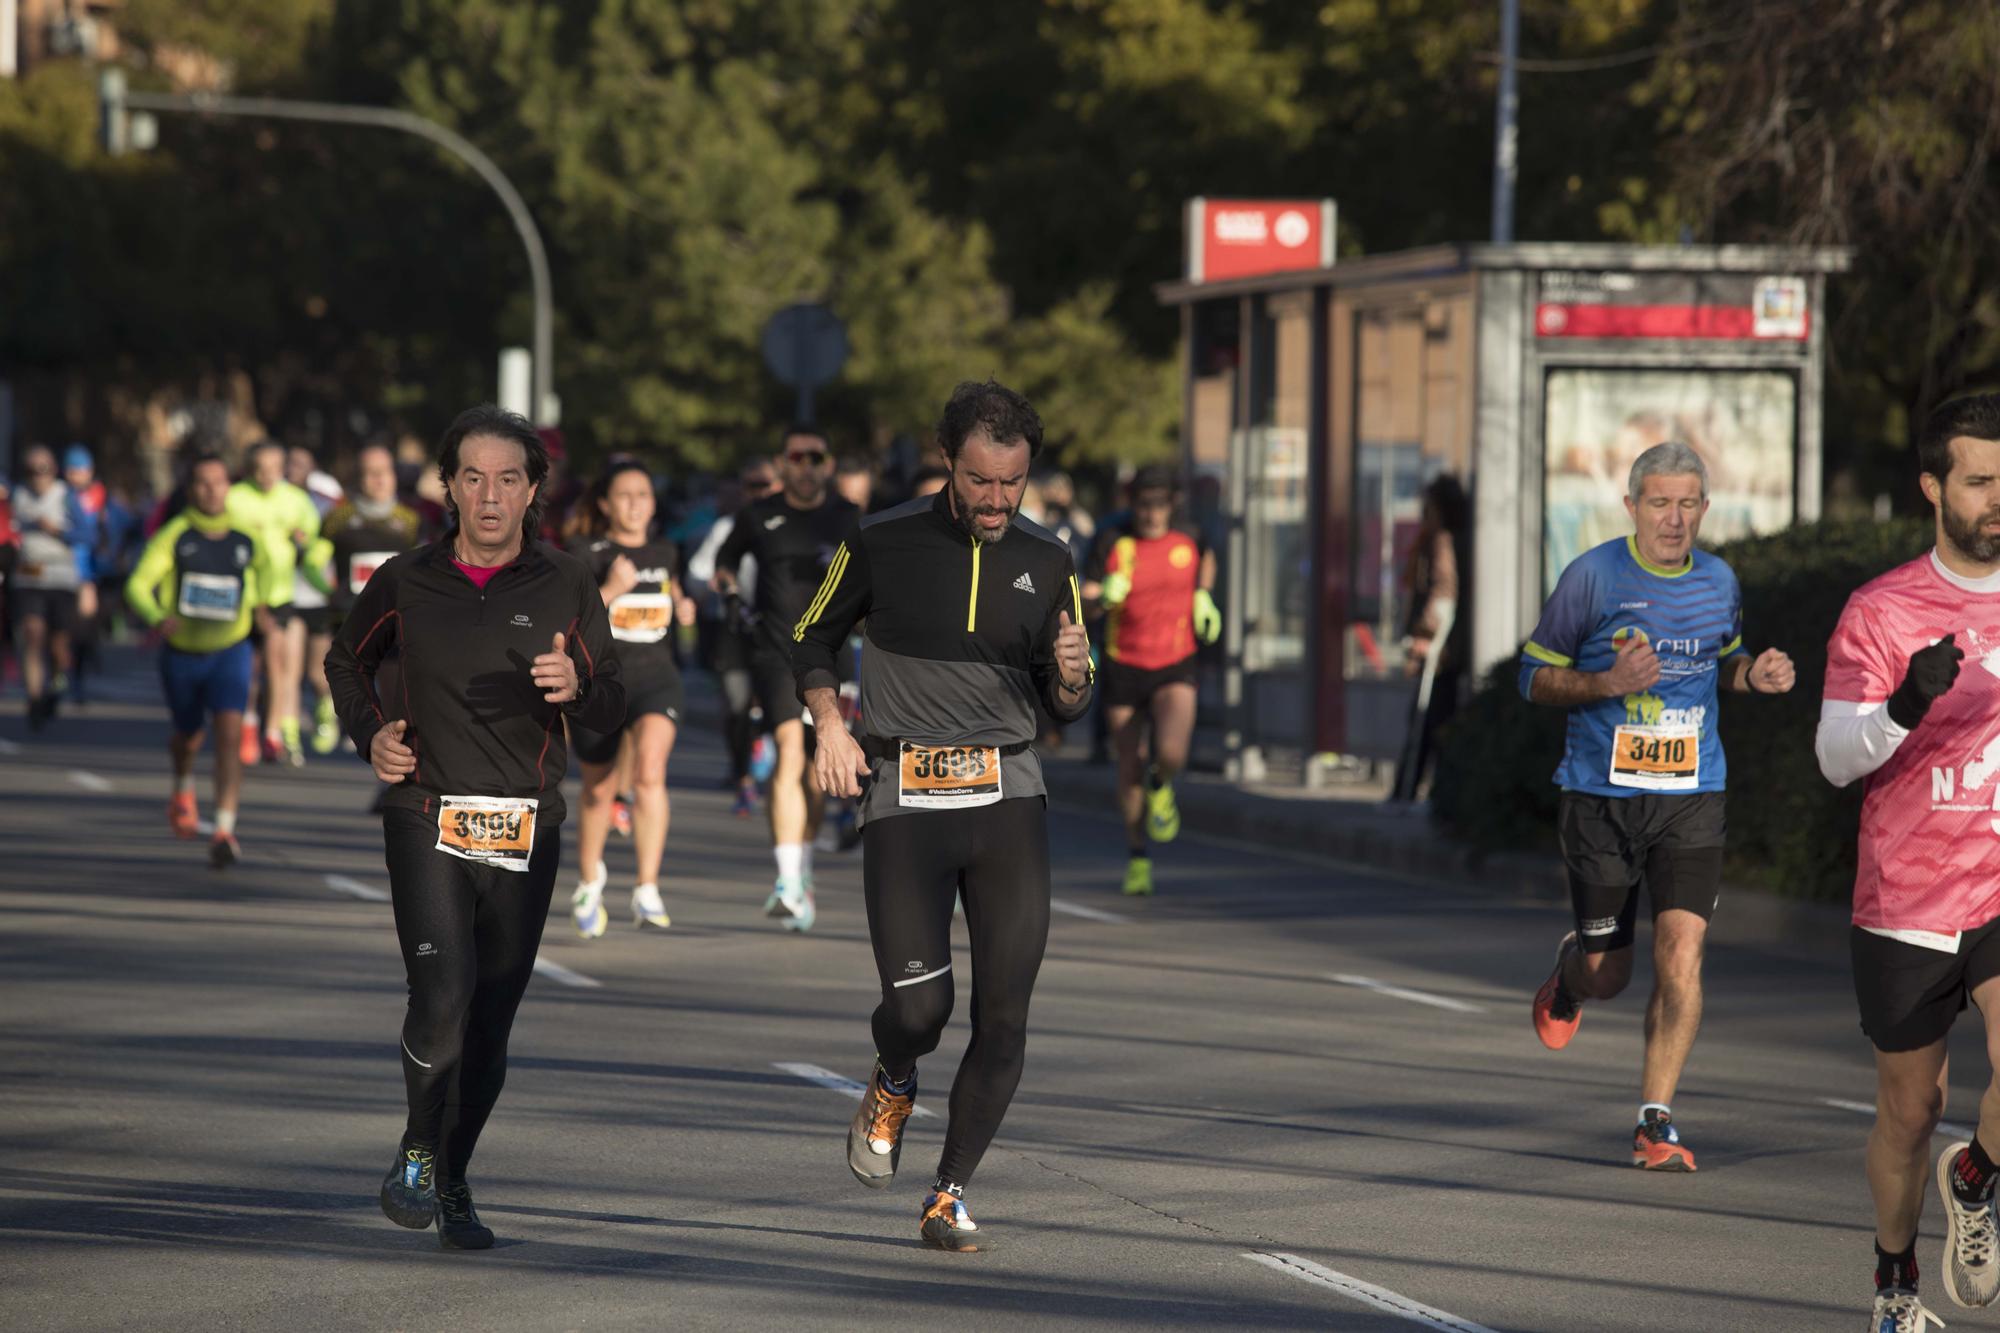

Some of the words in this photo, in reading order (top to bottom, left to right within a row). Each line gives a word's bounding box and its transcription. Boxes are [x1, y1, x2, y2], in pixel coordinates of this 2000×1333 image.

[1012, 581, 1036, 594] adidas
[914, 747, 986, 778] 3098
[1630, 736, 1685, 763] 3410
[453, 811, 521, 841] 3099
